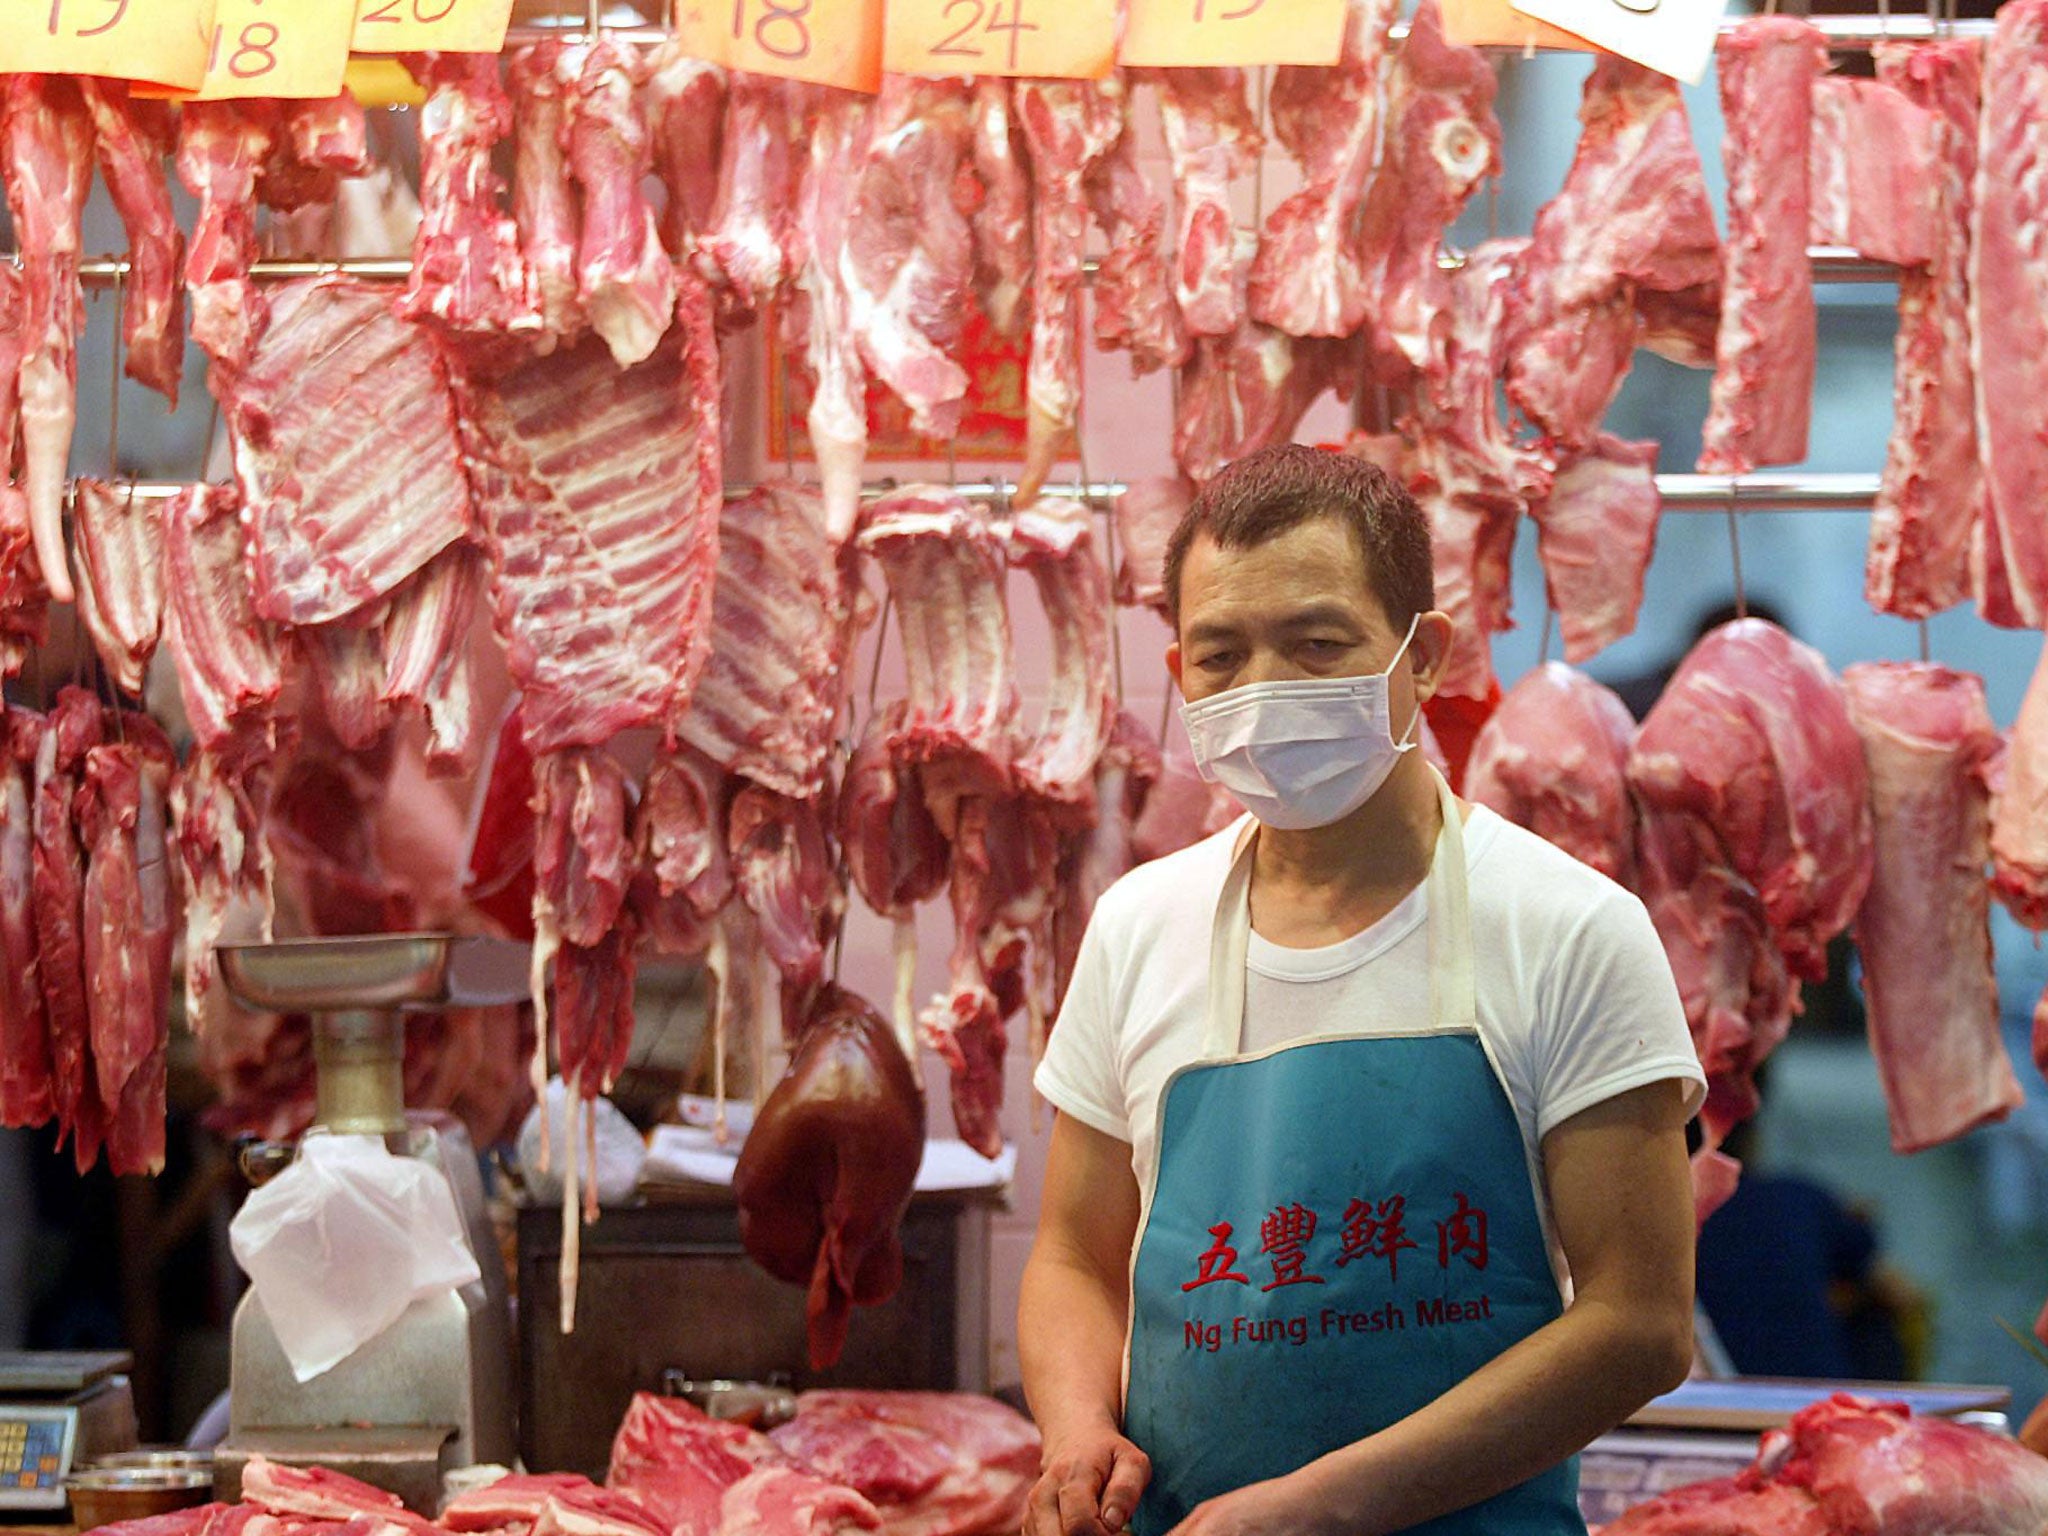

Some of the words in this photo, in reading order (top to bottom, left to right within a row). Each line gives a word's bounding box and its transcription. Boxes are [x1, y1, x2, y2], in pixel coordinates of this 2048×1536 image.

[208, 22, 279, 78] 18
[730, 0, 812, 60] 18
[928, 0, 1039, 69] 24
[1181, 1193, 1490, 1292] 五豐鮮肉
[1184, 1319, 1222, 1352] Ng
[1231, 1315, 1308, 1346] Fung
[1320, 1302, 1405, 1336] Fresh
[1416, 1295, 1495, 1327] Meat
